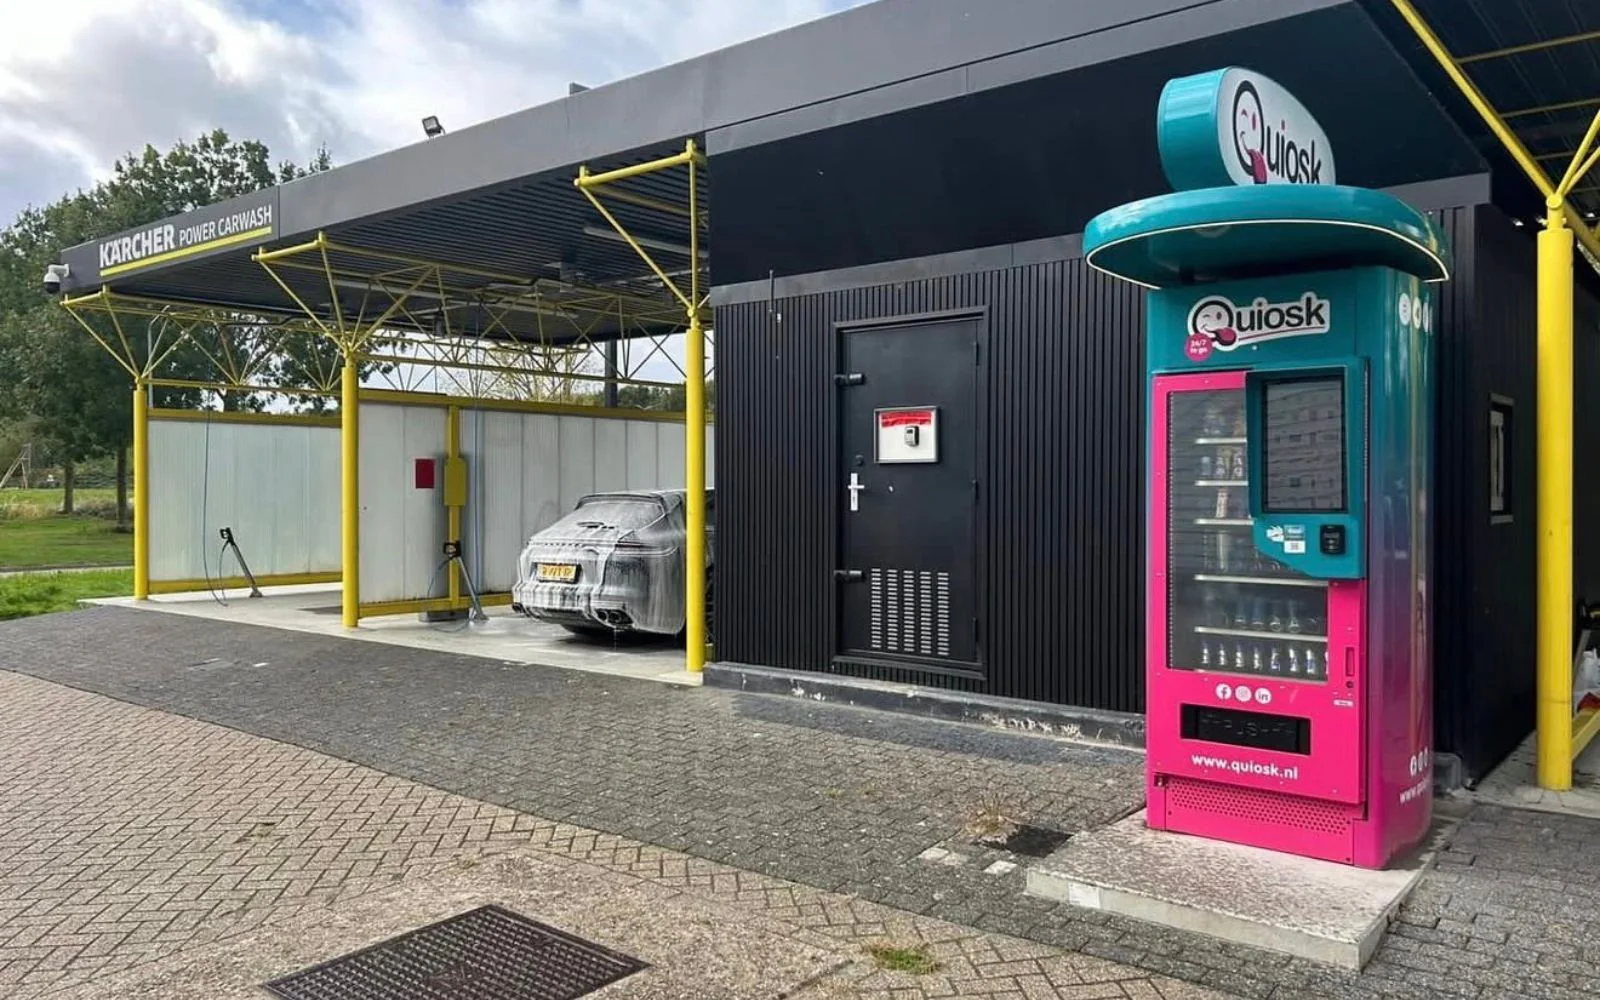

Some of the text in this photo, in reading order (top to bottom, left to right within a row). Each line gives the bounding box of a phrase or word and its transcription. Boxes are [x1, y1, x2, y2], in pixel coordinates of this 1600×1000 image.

[1233, 80, 1322, 184] Quiosk
[100, 204, 273, 268] KÄRCHER POWER CARWASH
[1192, 297, 1326, 345] Quiosk
[1191, 754, 1299, 779] www.quiosk.nl
